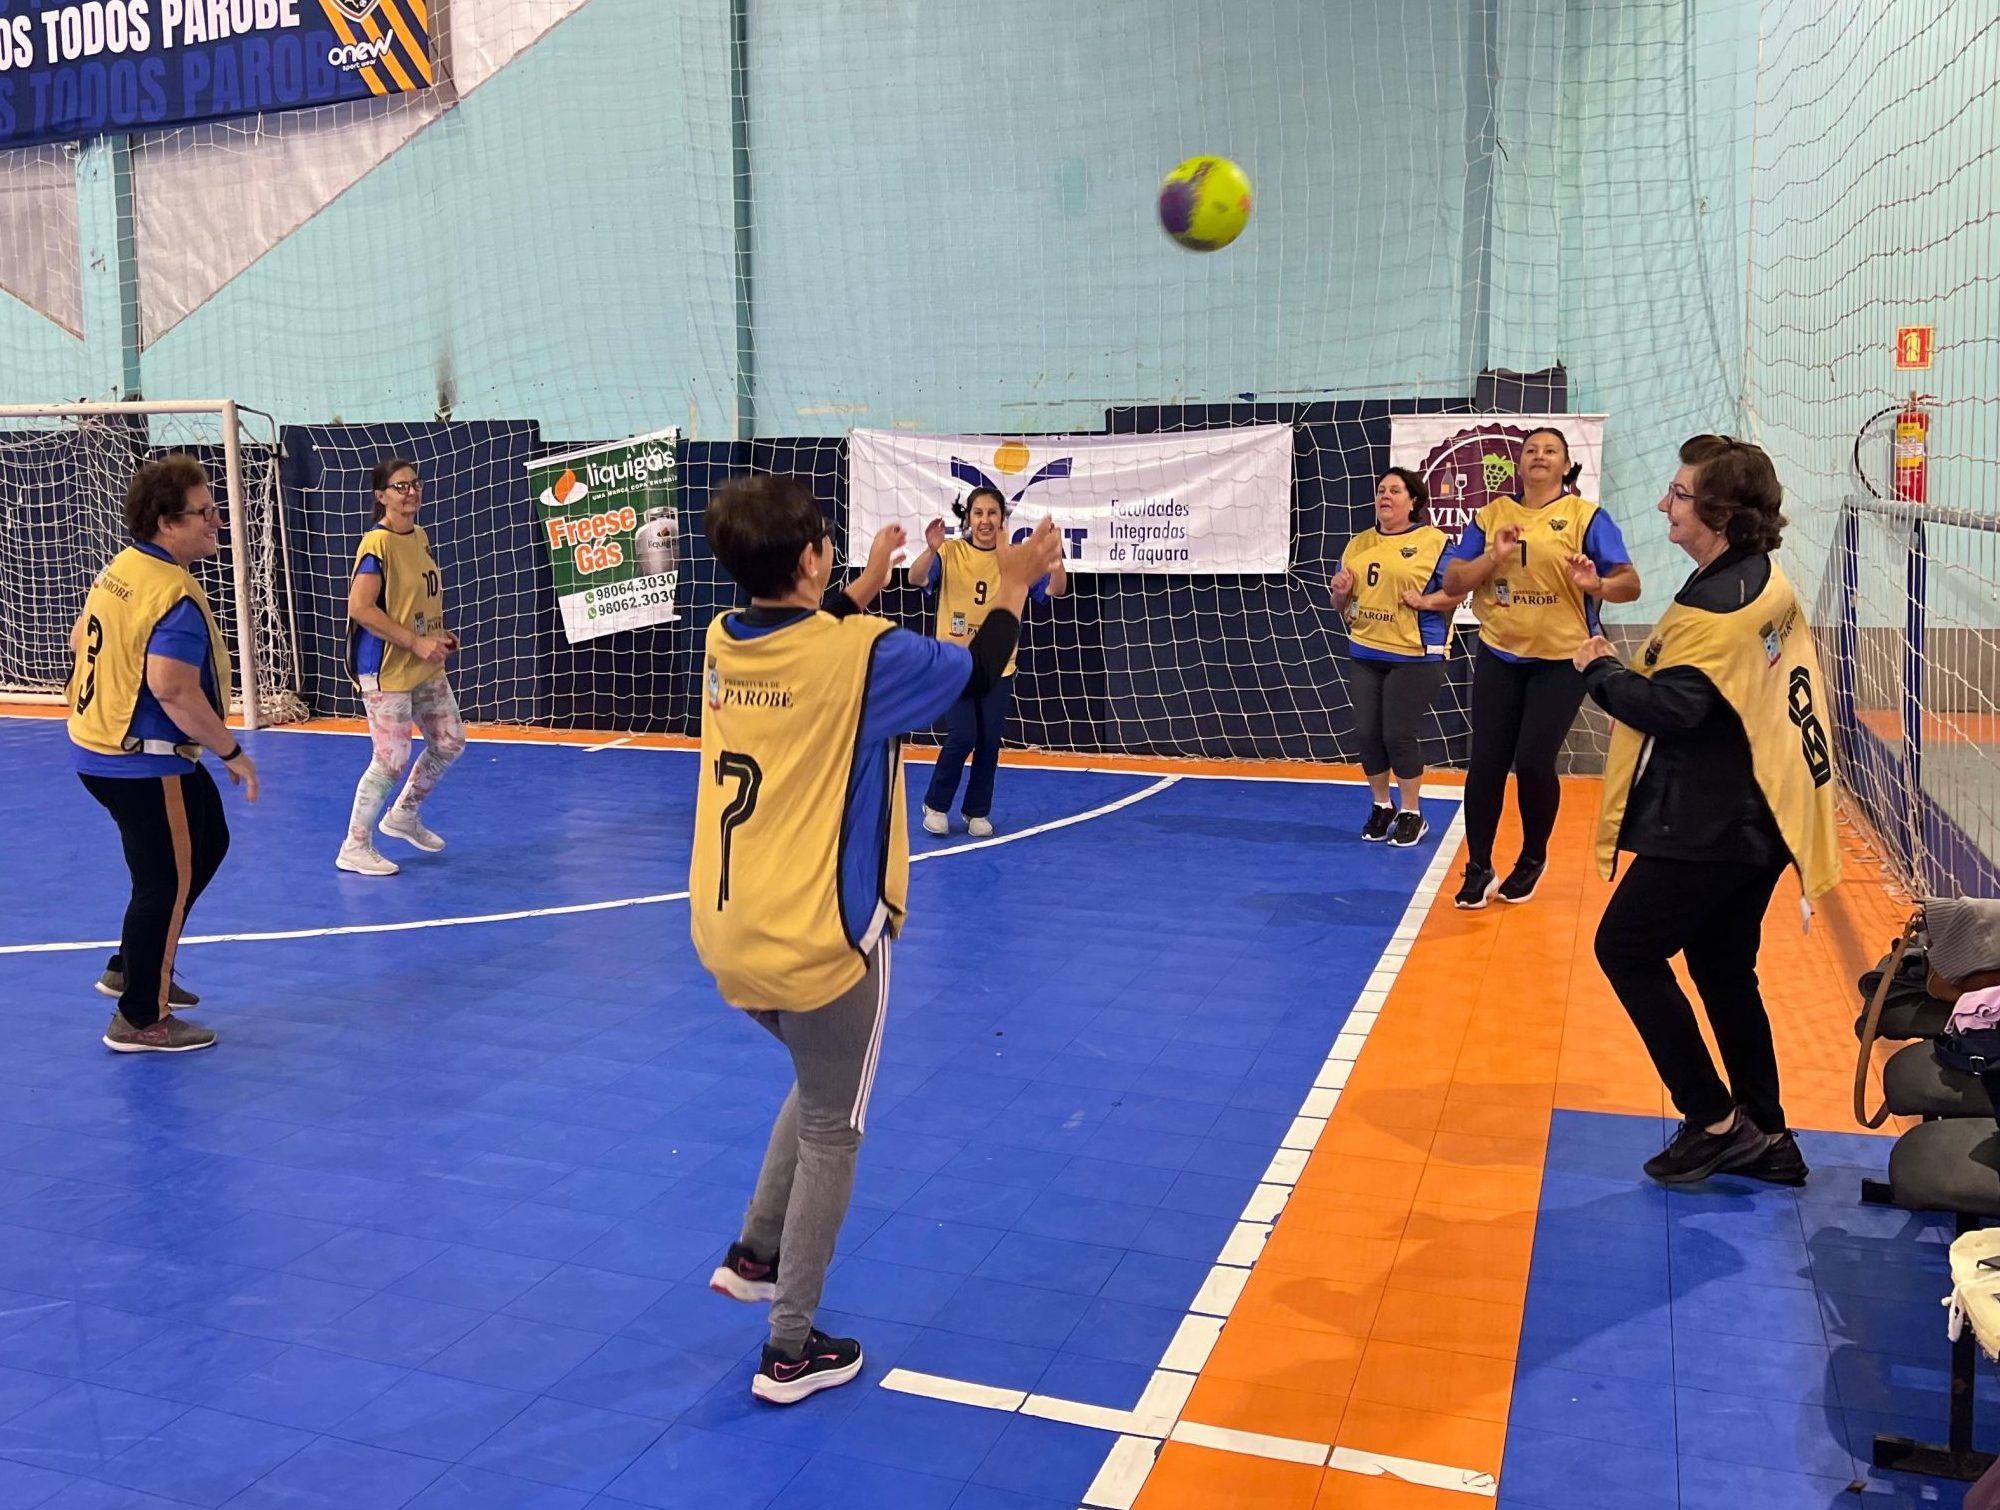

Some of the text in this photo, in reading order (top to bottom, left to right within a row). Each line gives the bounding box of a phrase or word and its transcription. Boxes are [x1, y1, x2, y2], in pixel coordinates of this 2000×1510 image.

[41, 0, 150, 64] TODOS
[328, 29, 393, 66] onew
[30, 57, 167, 135] TODOS
[592, 493, 606, 501] UMA
[607, 487, 629, 496] MARCA
[631, 481, 648, 491] COPA
[1111, 498, 1189, 517] Faculdades
[547, 507, 636, 549] Freese
[1110, 520, 1185, 543] Integradas
[575, 538, 623, 574] Gás
[1110, 543, 1189, 565] de Taquara
[422, 570, 438, 599] 10
[596, 573, 676, 601] 98064.3030
[1367, 563, 1381, 587] 6
[598, 589, 676, 616] 98062.3030
[974, 581, 988, 605] 9
[723, 686, 794, 708] PAROBÉ
